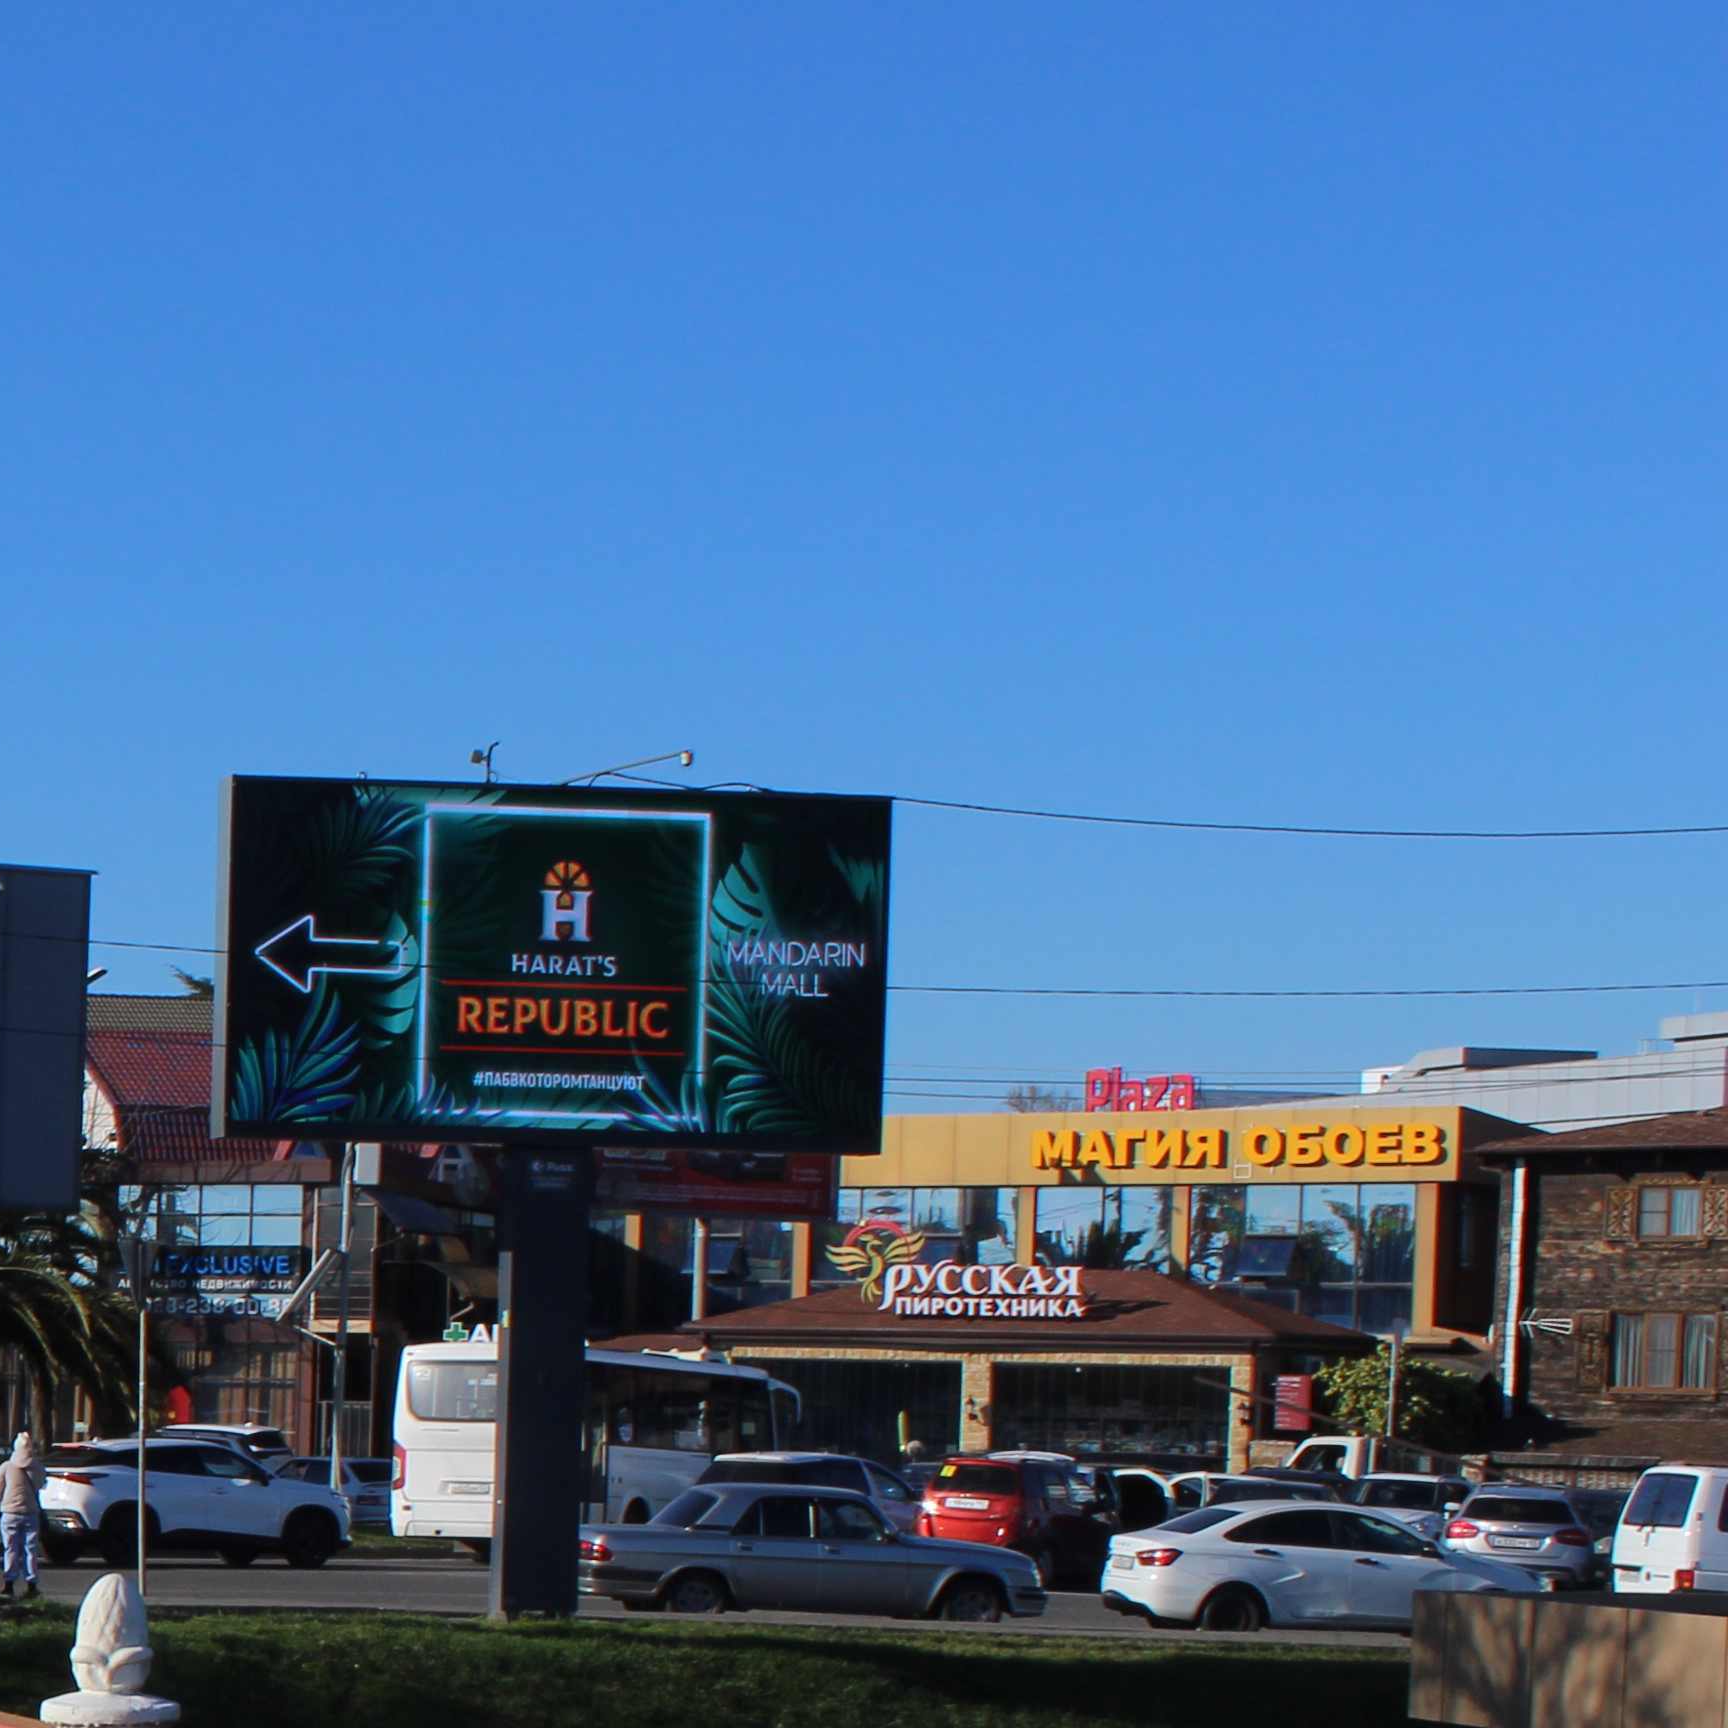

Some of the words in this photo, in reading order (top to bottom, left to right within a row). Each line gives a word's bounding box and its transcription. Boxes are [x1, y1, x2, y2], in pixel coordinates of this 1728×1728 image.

[511, 954, 617, 977] HARAT'S
[727, 941, 865, 967] MANDARIN
[759, 973, 829, 998] MALL
[456, 996, 670, 1039] REPUBLIC
[473, 1071, 645, 1090] #ПАБВКОТОРОМТАНЦУЮТ
[1085, 1066, 1197, 1113] Plaza
[1031, 1129, 1229, 1169] МАГИЯ
[1245, 1123, 1445, 1168] ОБОЕВ
[878, 1259, 1085, 1312] РУССКАЯ
[895, 1297, 1087, 1317] ПИРОТЕХНИКА
